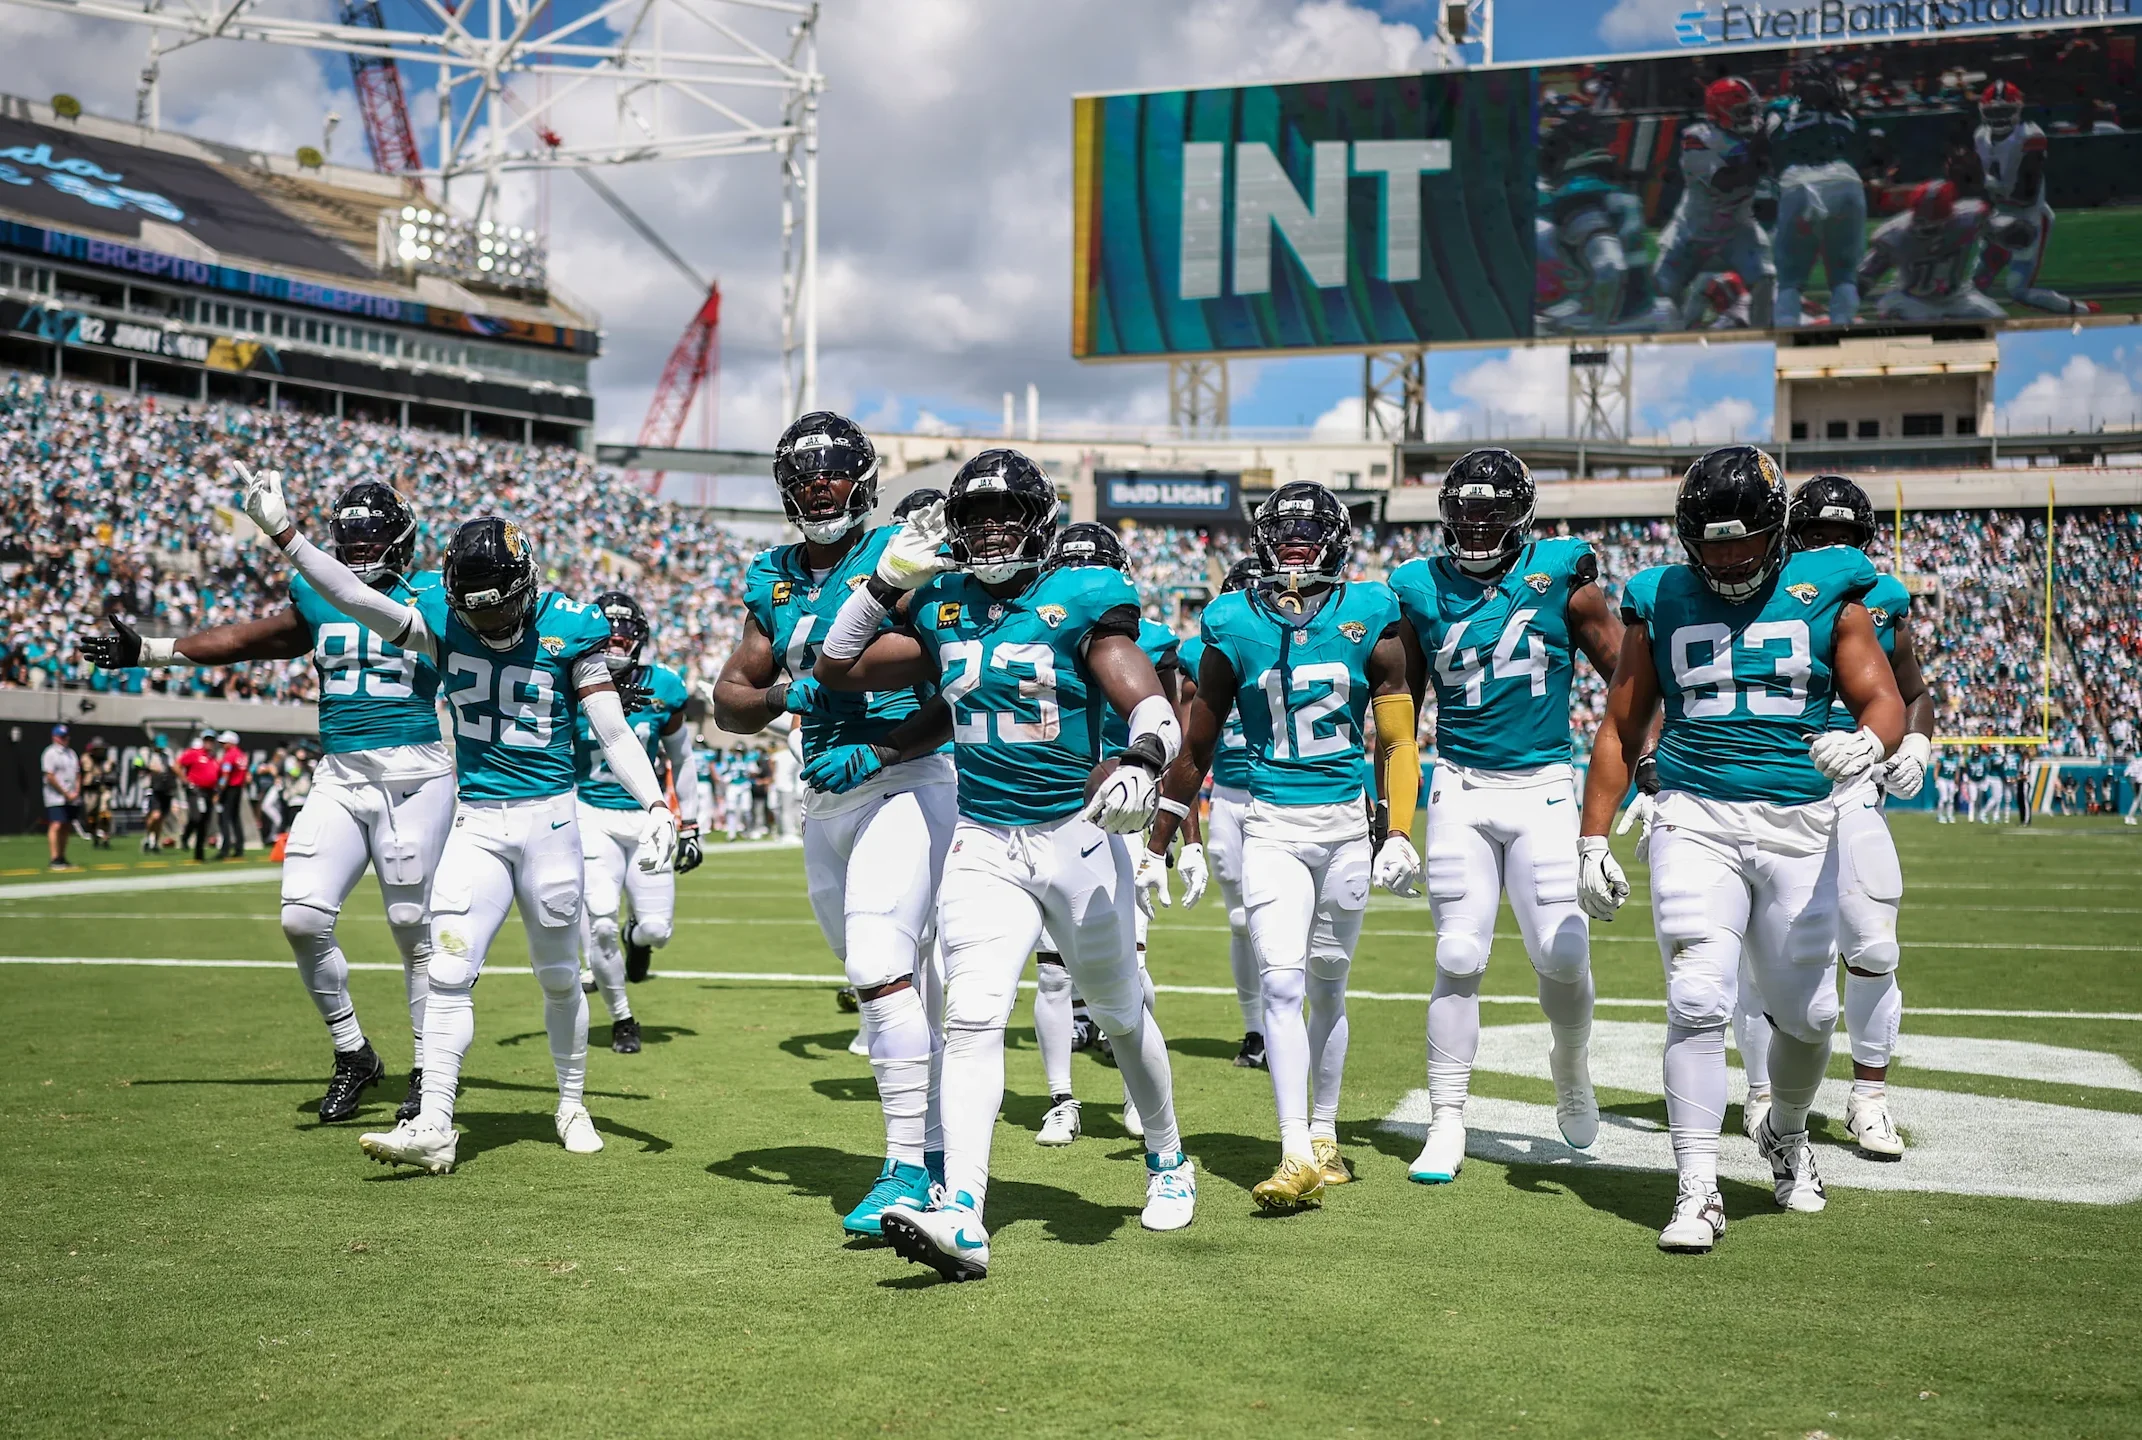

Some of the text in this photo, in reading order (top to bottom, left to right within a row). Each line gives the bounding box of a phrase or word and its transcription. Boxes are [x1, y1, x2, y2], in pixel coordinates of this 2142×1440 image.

[1722, 0, 1926, 41] EverBank
[1180, 139, 1451, 300] INT
[805, 436, 820, 446] JAX
[978, 478, 993, 488] JAX
[1111, 484, 1225, 505] BUD LIGHT
[1717, 526, 1731, 536] JAX
[773, 582, 791, 599] C
[939, 602, 960, 622] C
[1434, 608, 1549, 706] 44
[1671, 619, 1812, 718] 93
[448, 651, 555, 748] 29
[939, 640, 1061, 744] 23
[1258, 661, 1352, 759] 12
